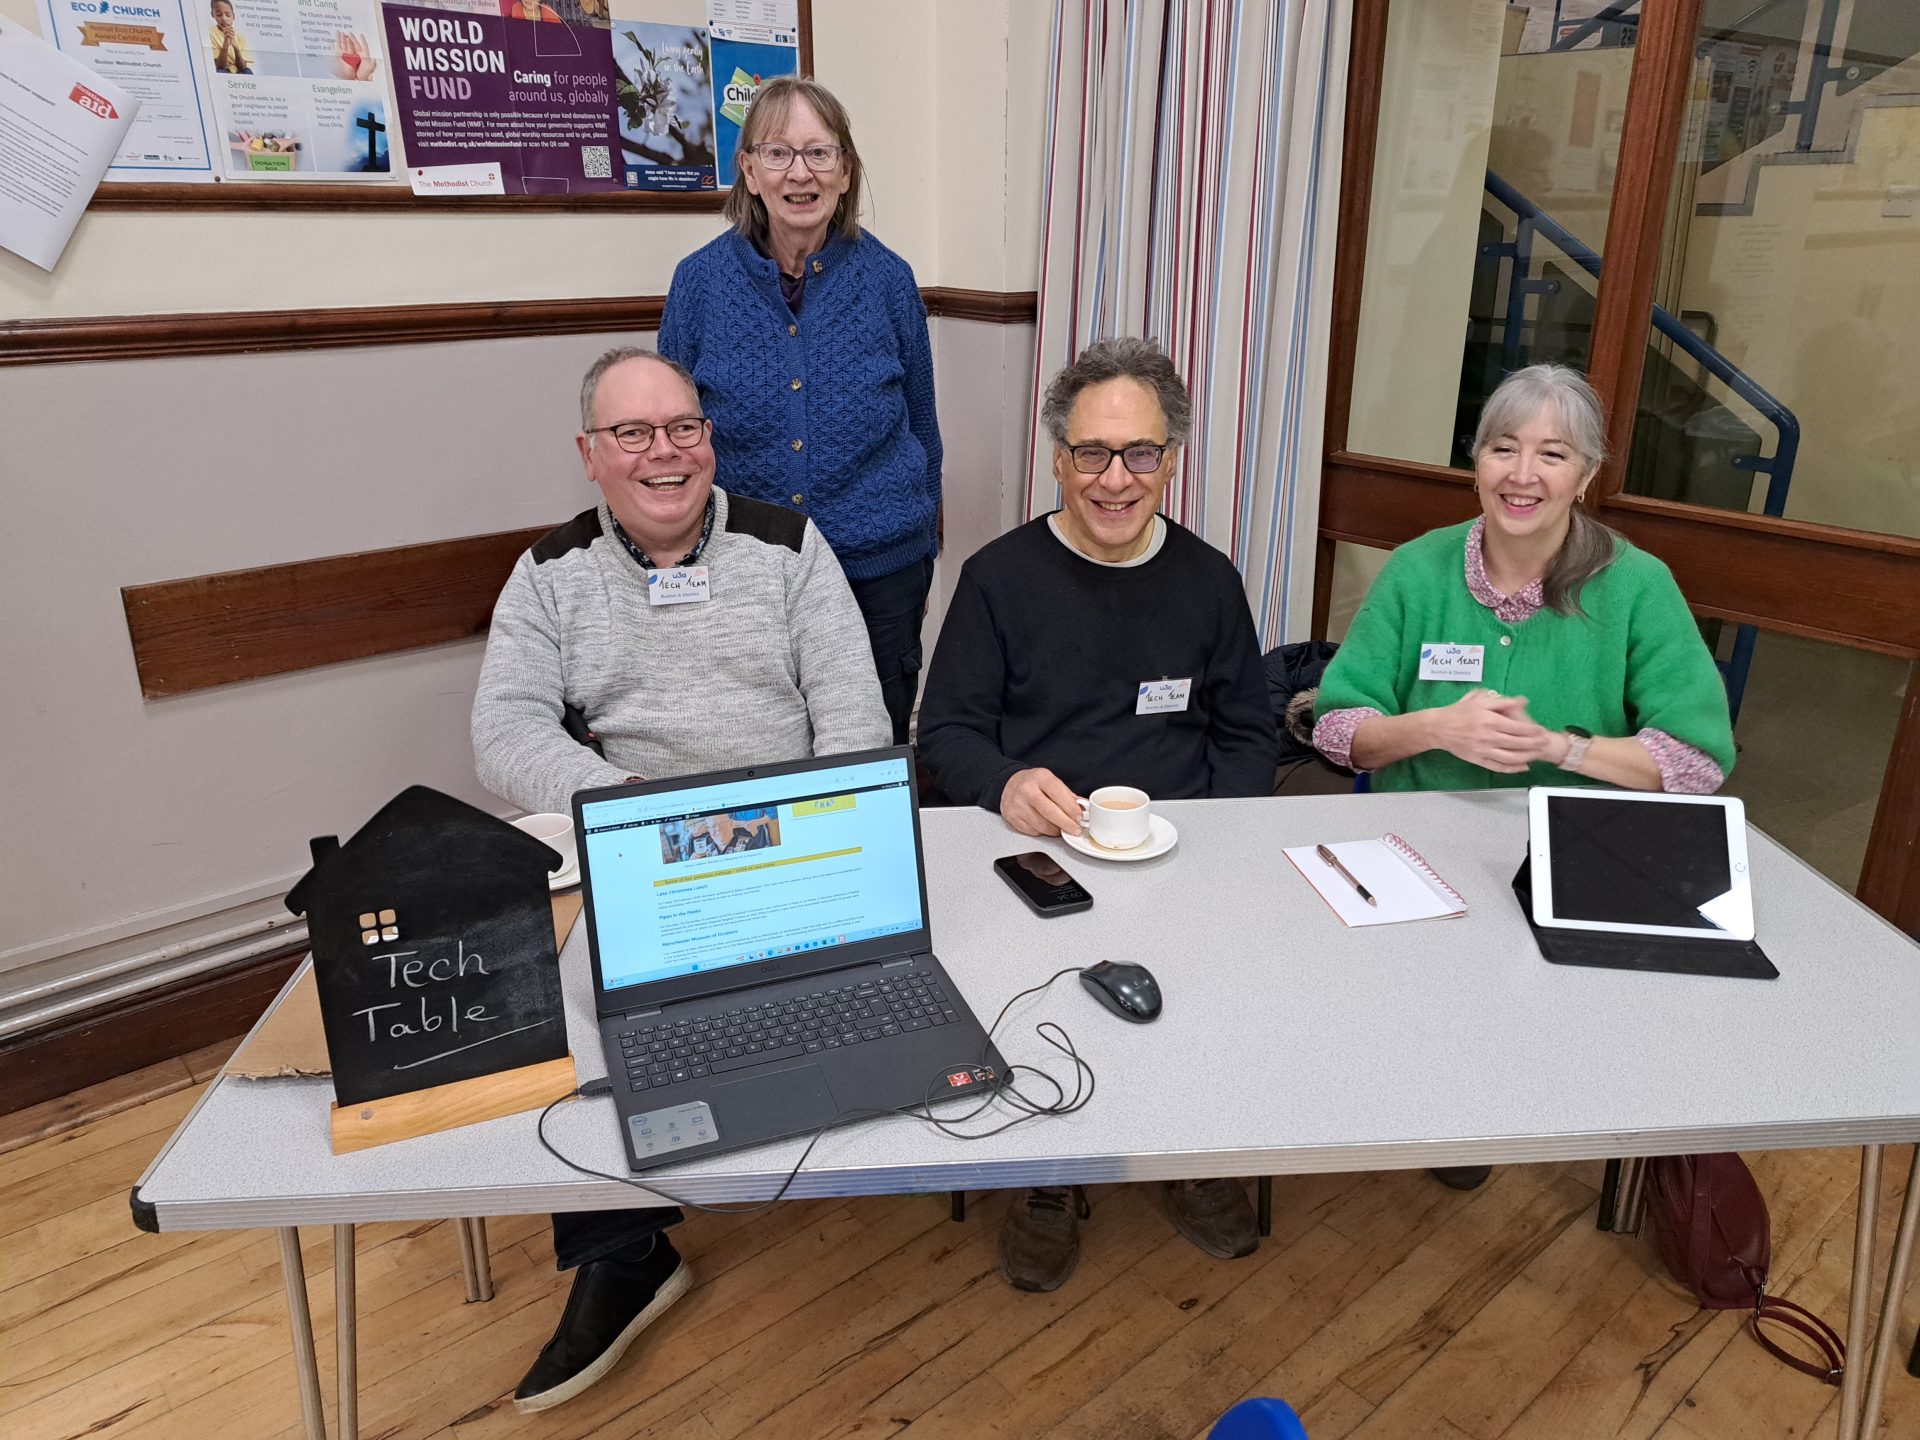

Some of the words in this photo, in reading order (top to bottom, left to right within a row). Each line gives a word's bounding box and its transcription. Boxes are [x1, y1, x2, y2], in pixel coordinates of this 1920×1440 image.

[71, 2, 97, 12] ECO
[112, 5, 161, 18] CHURCH
[314, 0, 338, 10] Caring
[398, 17, 483, 44] WORLD
[662, 40, 680, 60] Living
[404, 46, 505, 73] MISSION
[228, 80, 256, 90] Service
[513, 70, 551, 87] Caring
[554, 71, 569, 84] for
[572, 73, 608, 88] people
[312, 84, 353, 95] Evangelism
[409, 76, 472, 100] FUND
[509, 89, 547, 102] around
[550, 93, 566, 104] us,
[568, 90, 609, 106] globally
[78, 96, 112, 119] aid
[659, 576, 680, 589] TECH
[686, 576, 706, 587] TEAM
[1429, 655, 1451, 665] TECH
[1457, 656, 1480, 666] TEAM
[1145, 690, 1163, 702] TECH
[1168, 689, 1184, 700] TEAM
[372, 940, 490, 988] Tech
[352, 996, 500, 1042] Table
